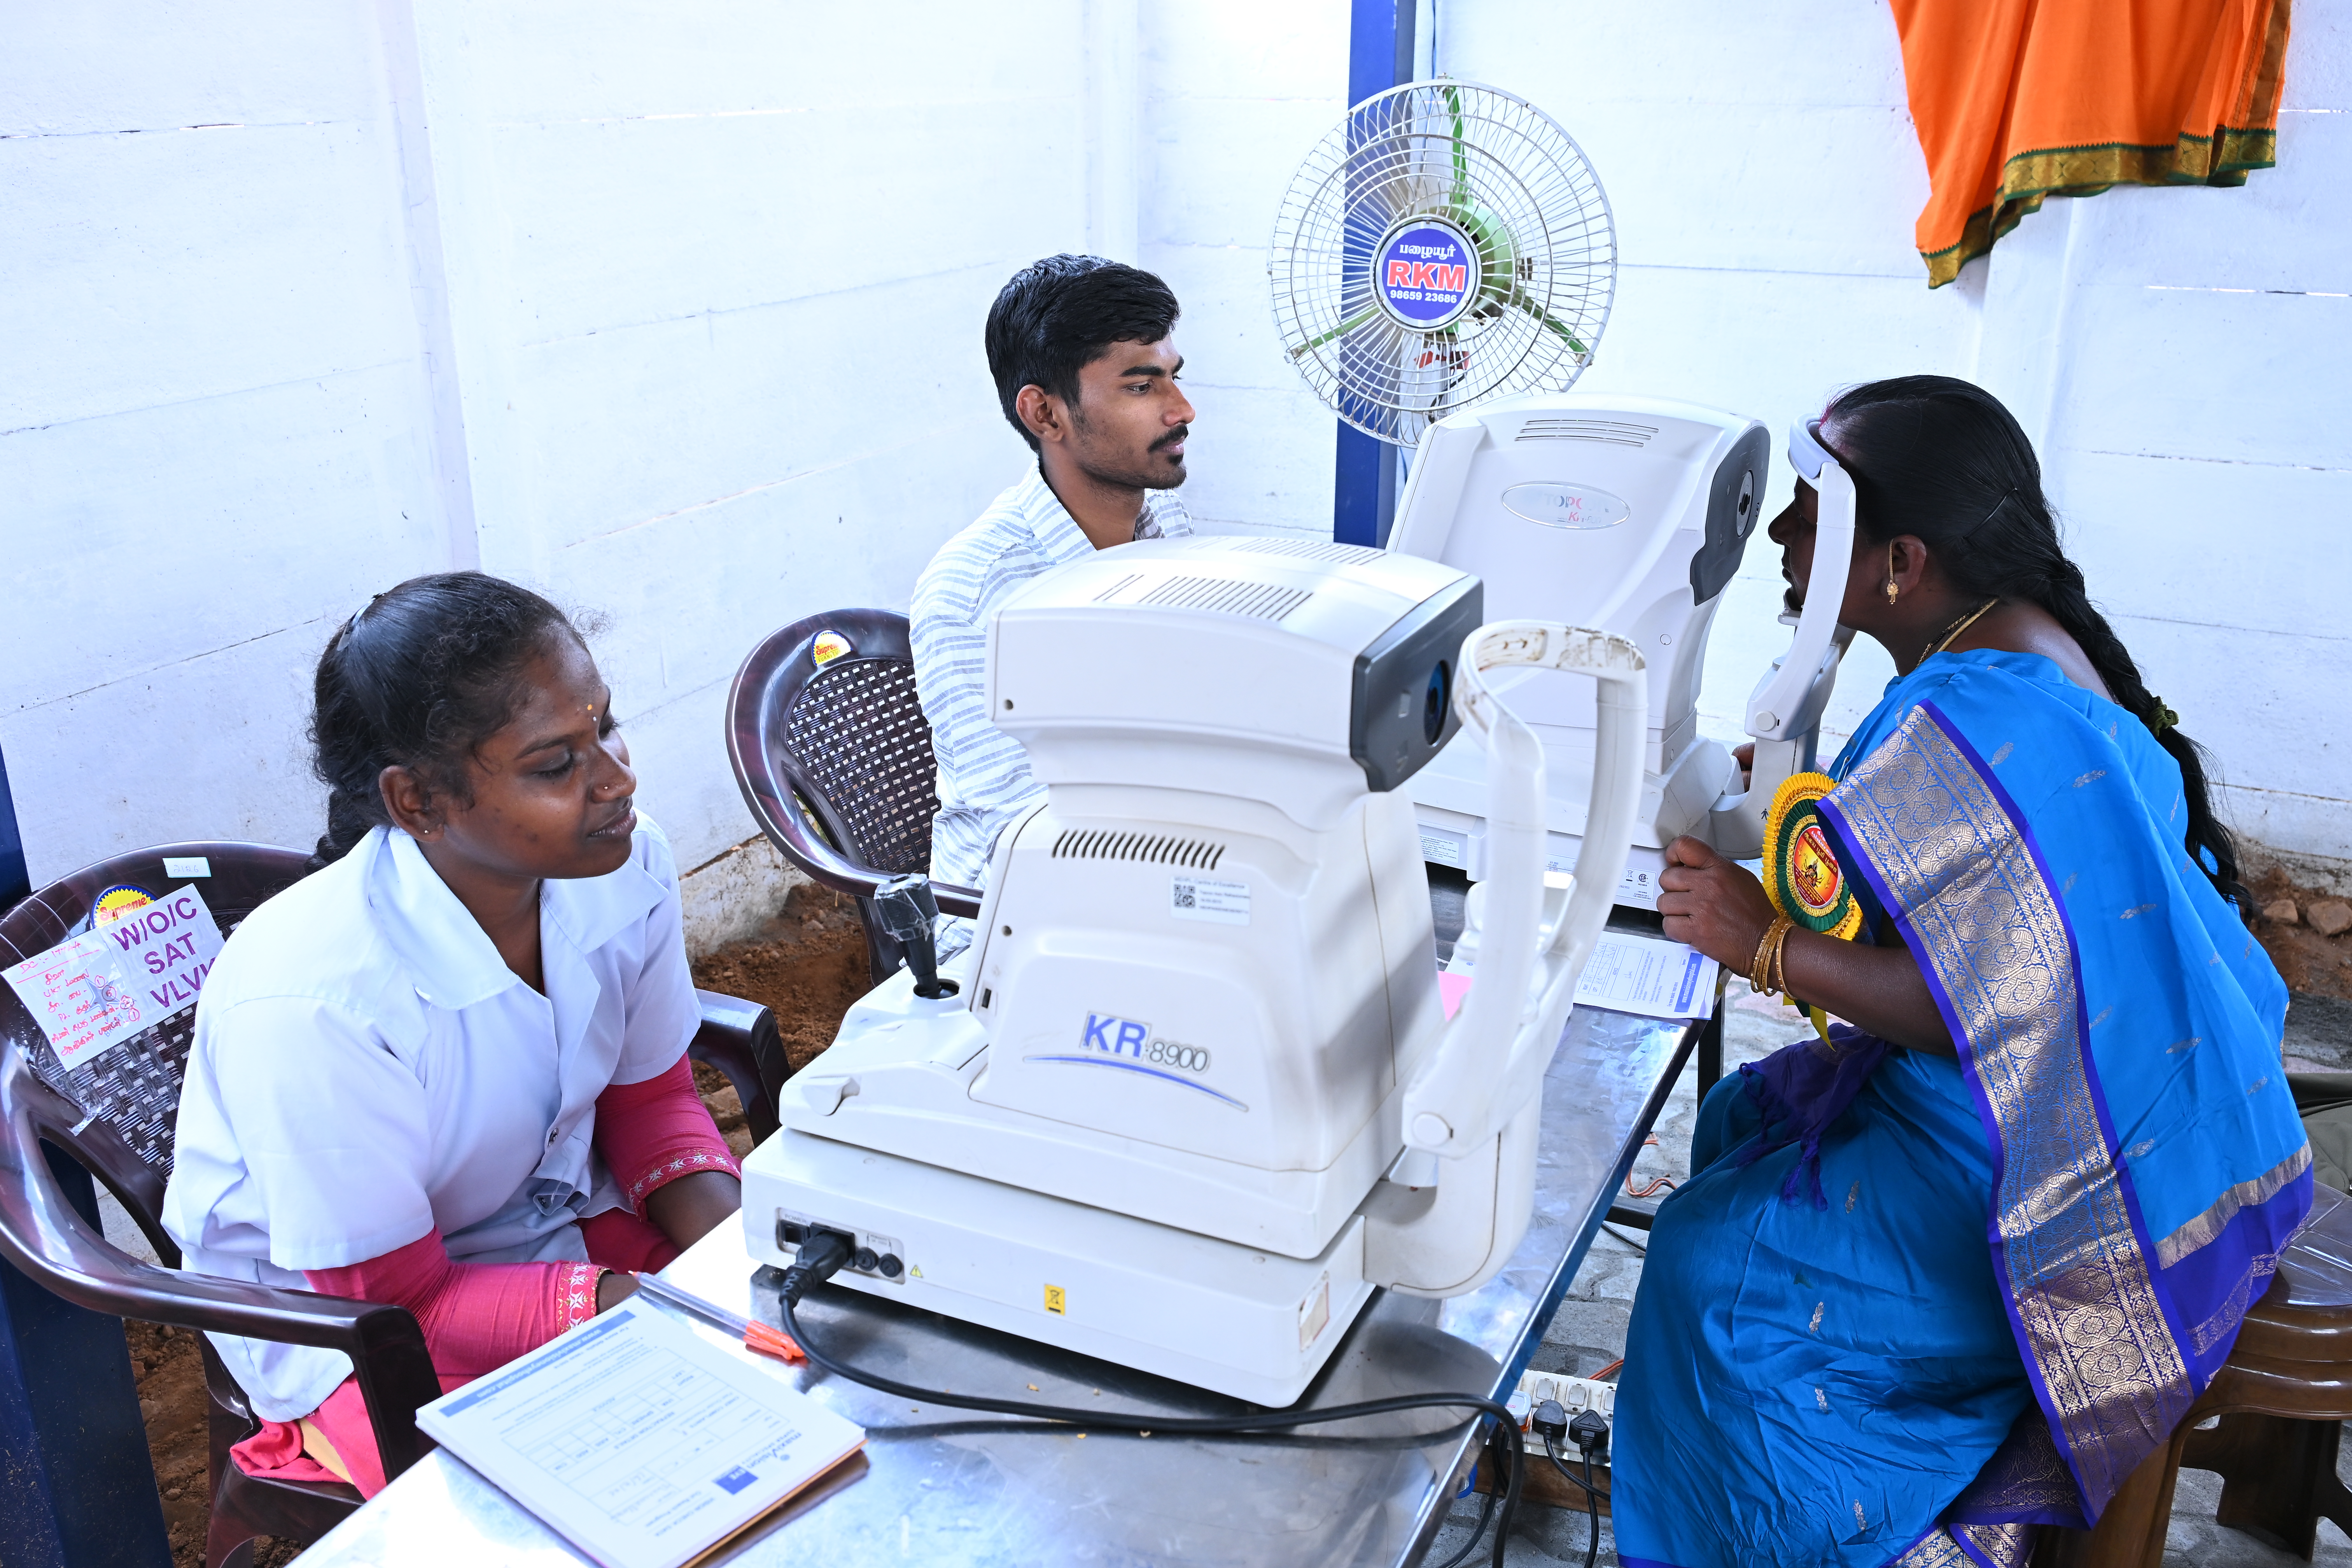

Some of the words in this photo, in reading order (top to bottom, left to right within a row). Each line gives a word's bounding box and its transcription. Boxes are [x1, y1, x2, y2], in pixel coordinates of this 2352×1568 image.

[1387, 260, 1466, 292] RKM
[1390, 290, 1422, 301] 98659
[1424, 292, 1457, 303] 23686
[1804, 832, 1816, 848] ஆலய
[1816, 847, 1825, 859] பூமி
[1825, 857, 1837, 873] பூஜை
[173, 864, 199, 873] 2126
[100, 896, 147, 921] Supreme
[110, 897, 197, 951] W/O/C
[144, 933, 196, 975] SAT
[785, 1214, 806, 1223] POWER
[476, 1328, 602, 1398] www.maxivisioneyehospital.com
[671, 1370, 685, 1379] LEFT
[676, 1375, 694, 1386] RIGHT
[592, 1397, 616, 1412] ADVICE
[630, 1410, 654, 1425] SPHERE
[637, 1411, 676, 1434] REFRACTION
[613, 1433, 639, 1449] DETAILS
[728, 1468, 746, 1480] EYE
